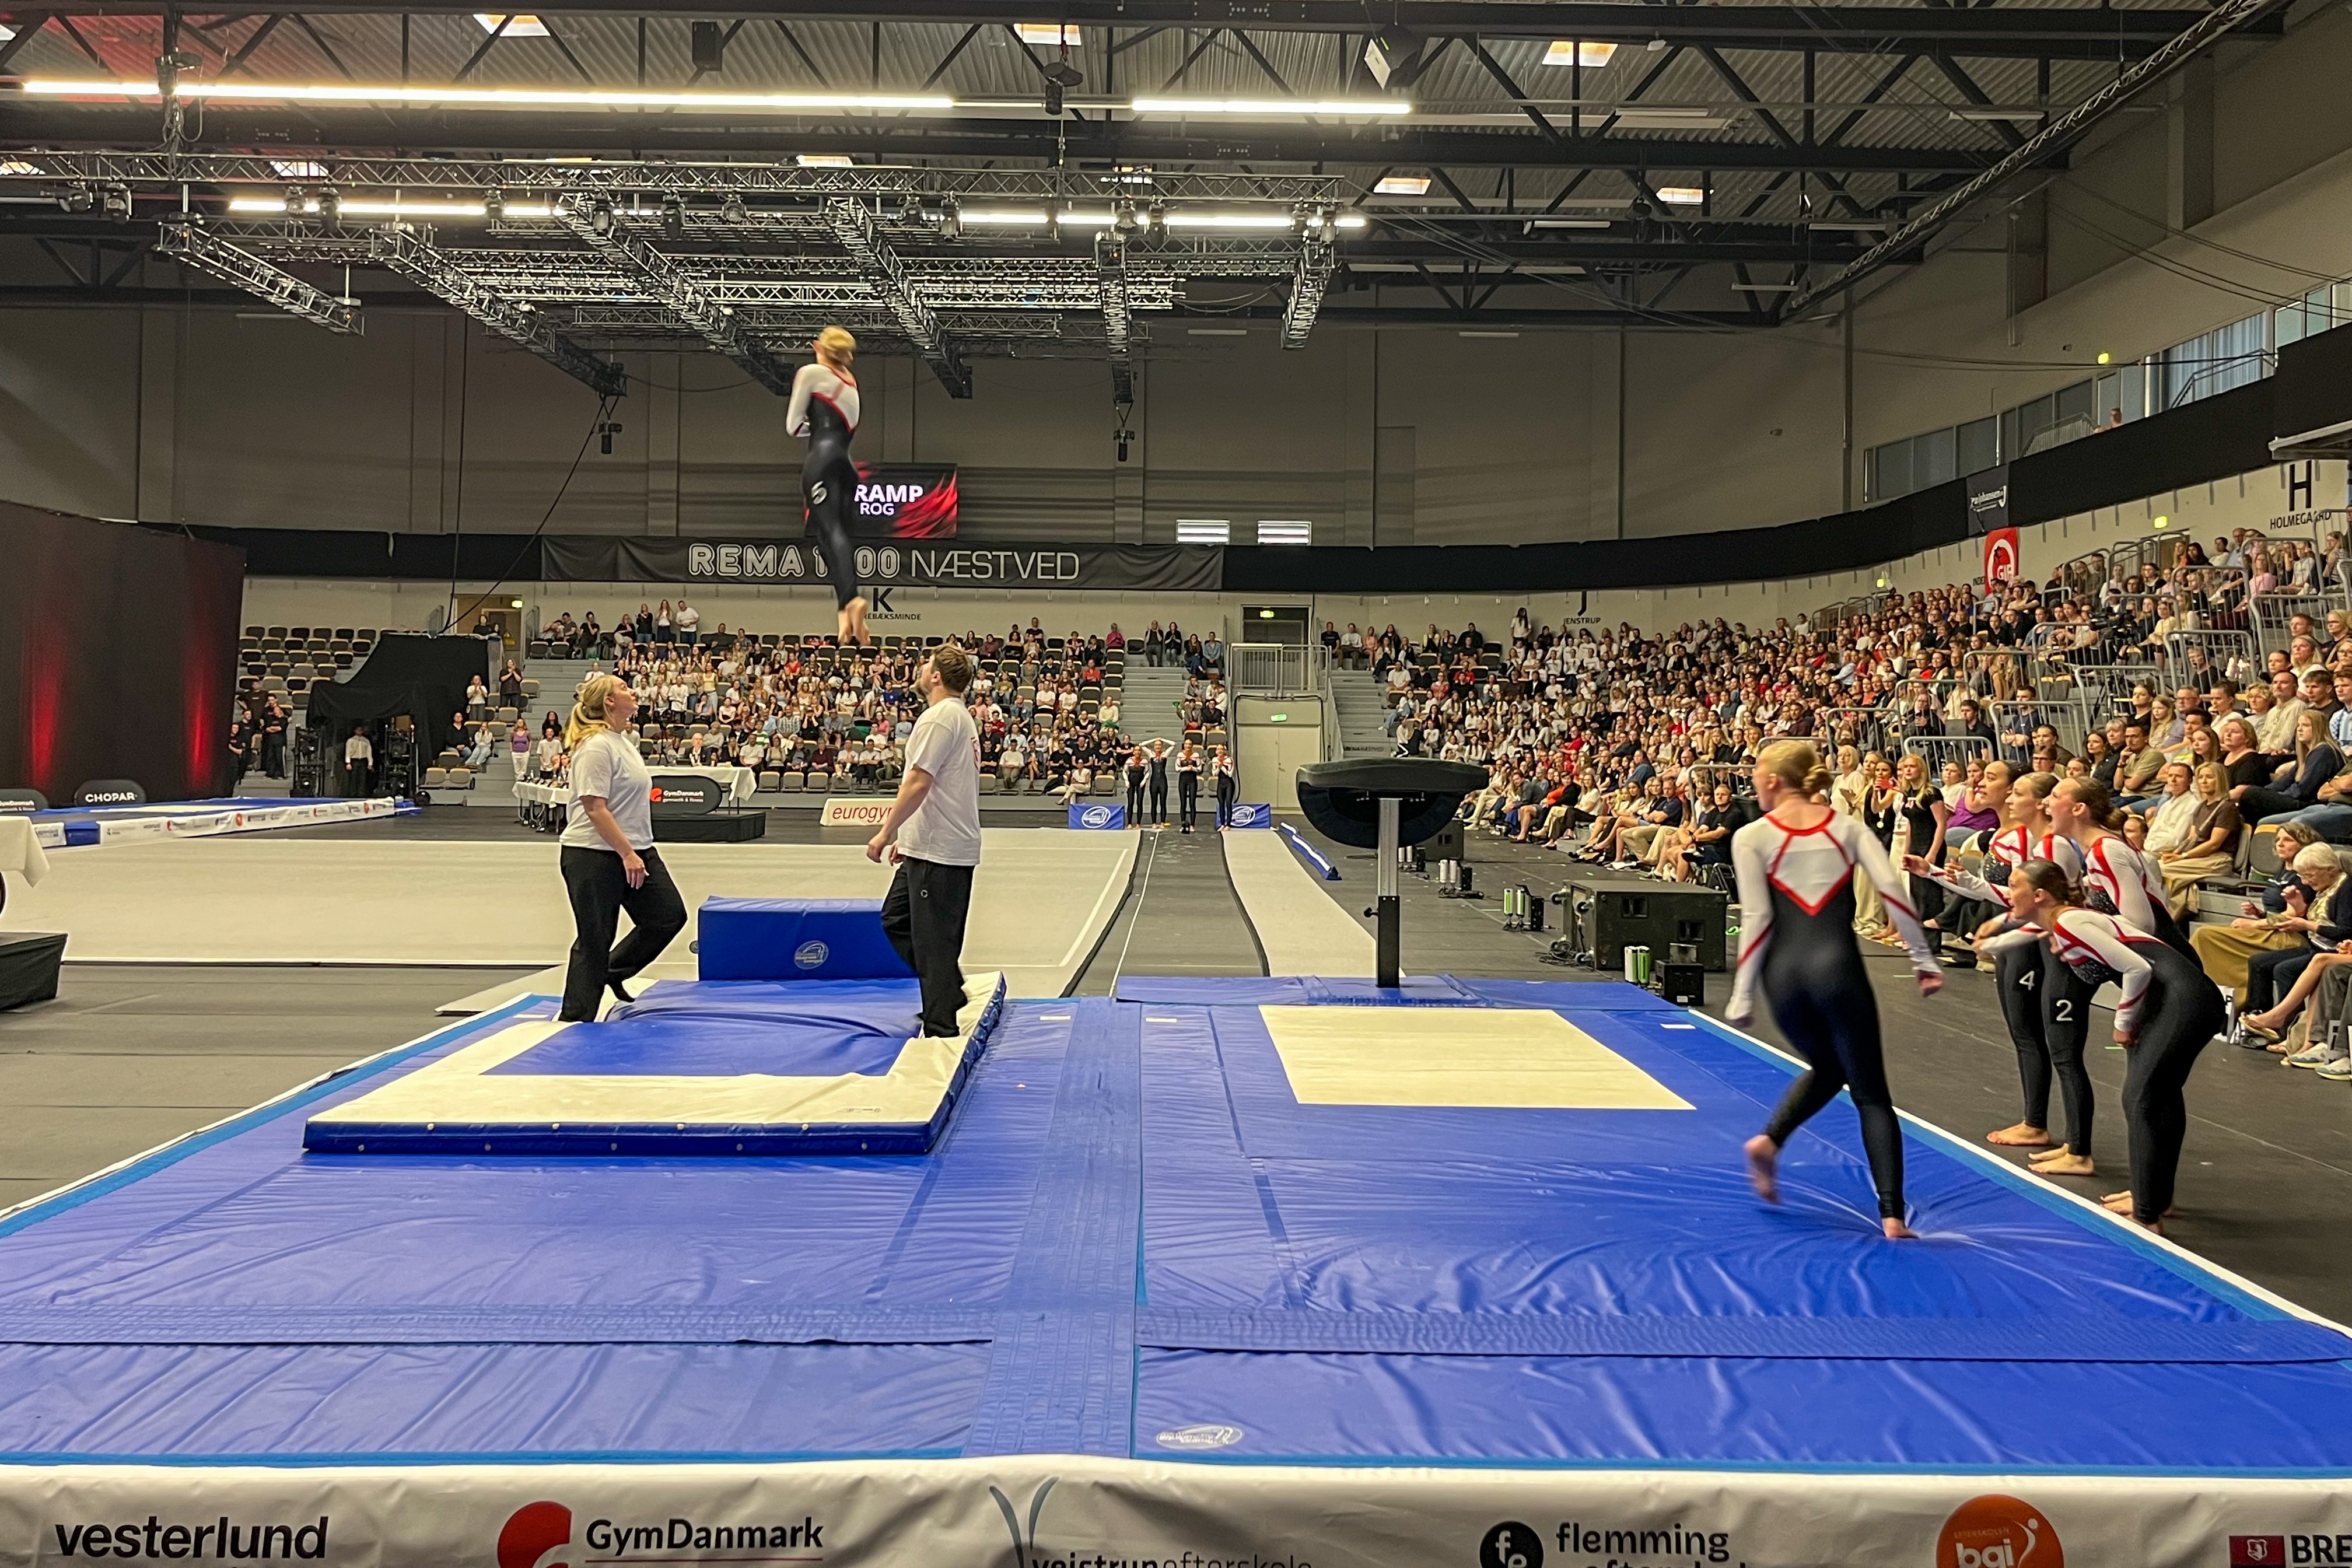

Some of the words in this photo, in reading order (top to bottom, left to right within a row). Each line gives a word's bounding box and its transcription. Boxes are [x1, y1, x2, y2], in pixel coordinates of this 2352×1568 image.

[811, 480, 828, 505] 5
[854, 484, 923, 502] RAMP
[2289, 460, 2312, 512] H
[860, 503, 895, 515] ROG
[689, 543, 805, 578] REMA
[813, 546, 900, 579] 100
[911, 550, 1079, 580] NÆSTVED
[873, 587, 894, 612] K
[1577, 590, 1587, 616] J
[85, 792, 135, 803] CHOPAR
[2019, 971, 2035, 991] 4
[2056, 999, 2073, 1021] 2
[55, 1516, 328, 1559] vesterlund
[586, 1517, 823, 1556] GymDanmark
[1556, 1522, 1730, 1563] flemming
[2291, 1535, 2352, 1563] BRE
